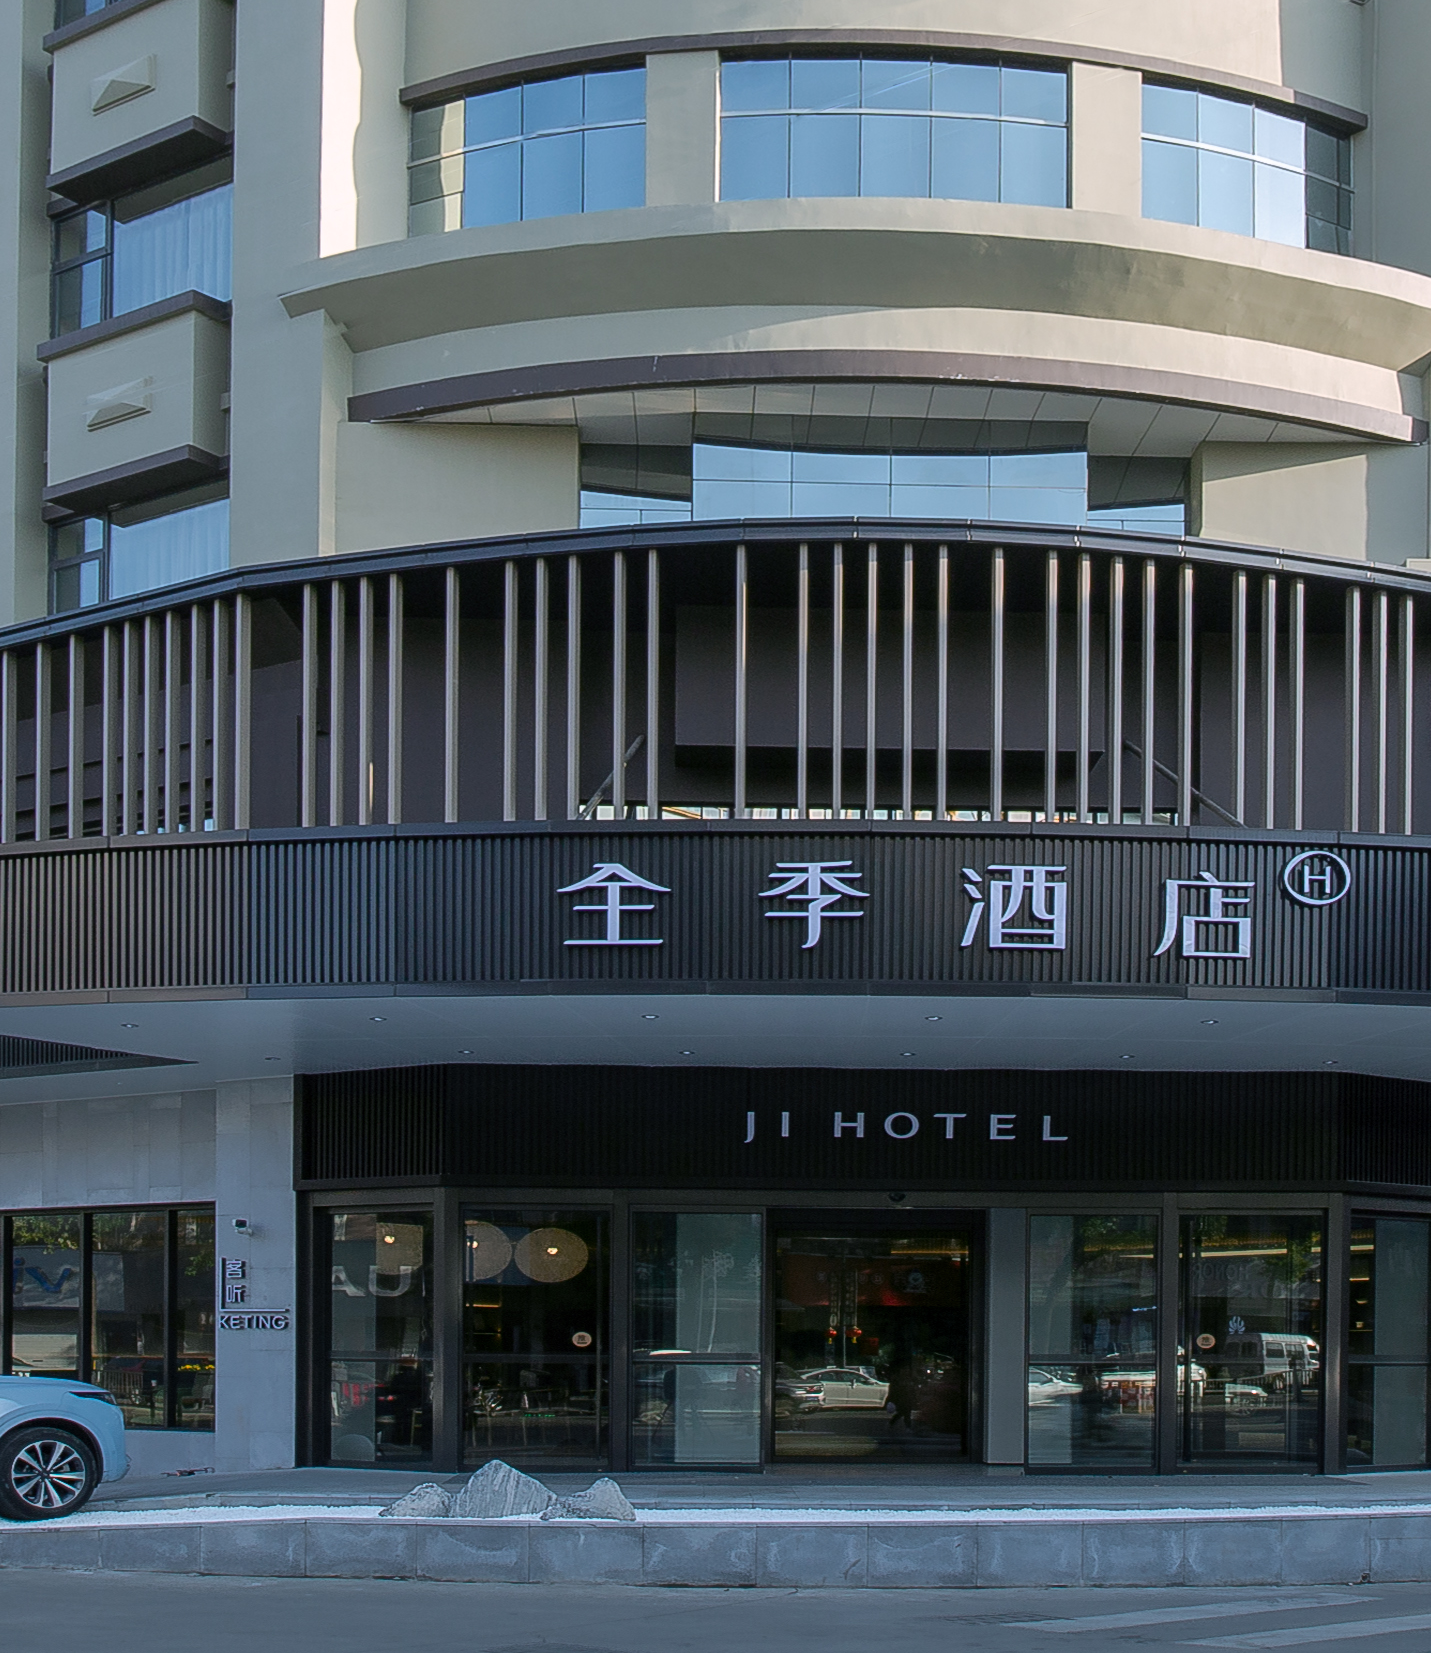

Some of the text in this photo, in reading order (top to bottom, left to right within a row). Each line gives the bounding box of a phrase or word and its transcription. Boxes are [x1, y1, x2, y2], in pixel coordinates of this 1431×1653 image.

[557, 860, 1255, 960] 全季酒店
[744, 1111, 1069, 1143] JI HOTEL
[219, 1315, 287, 1330] KETING
